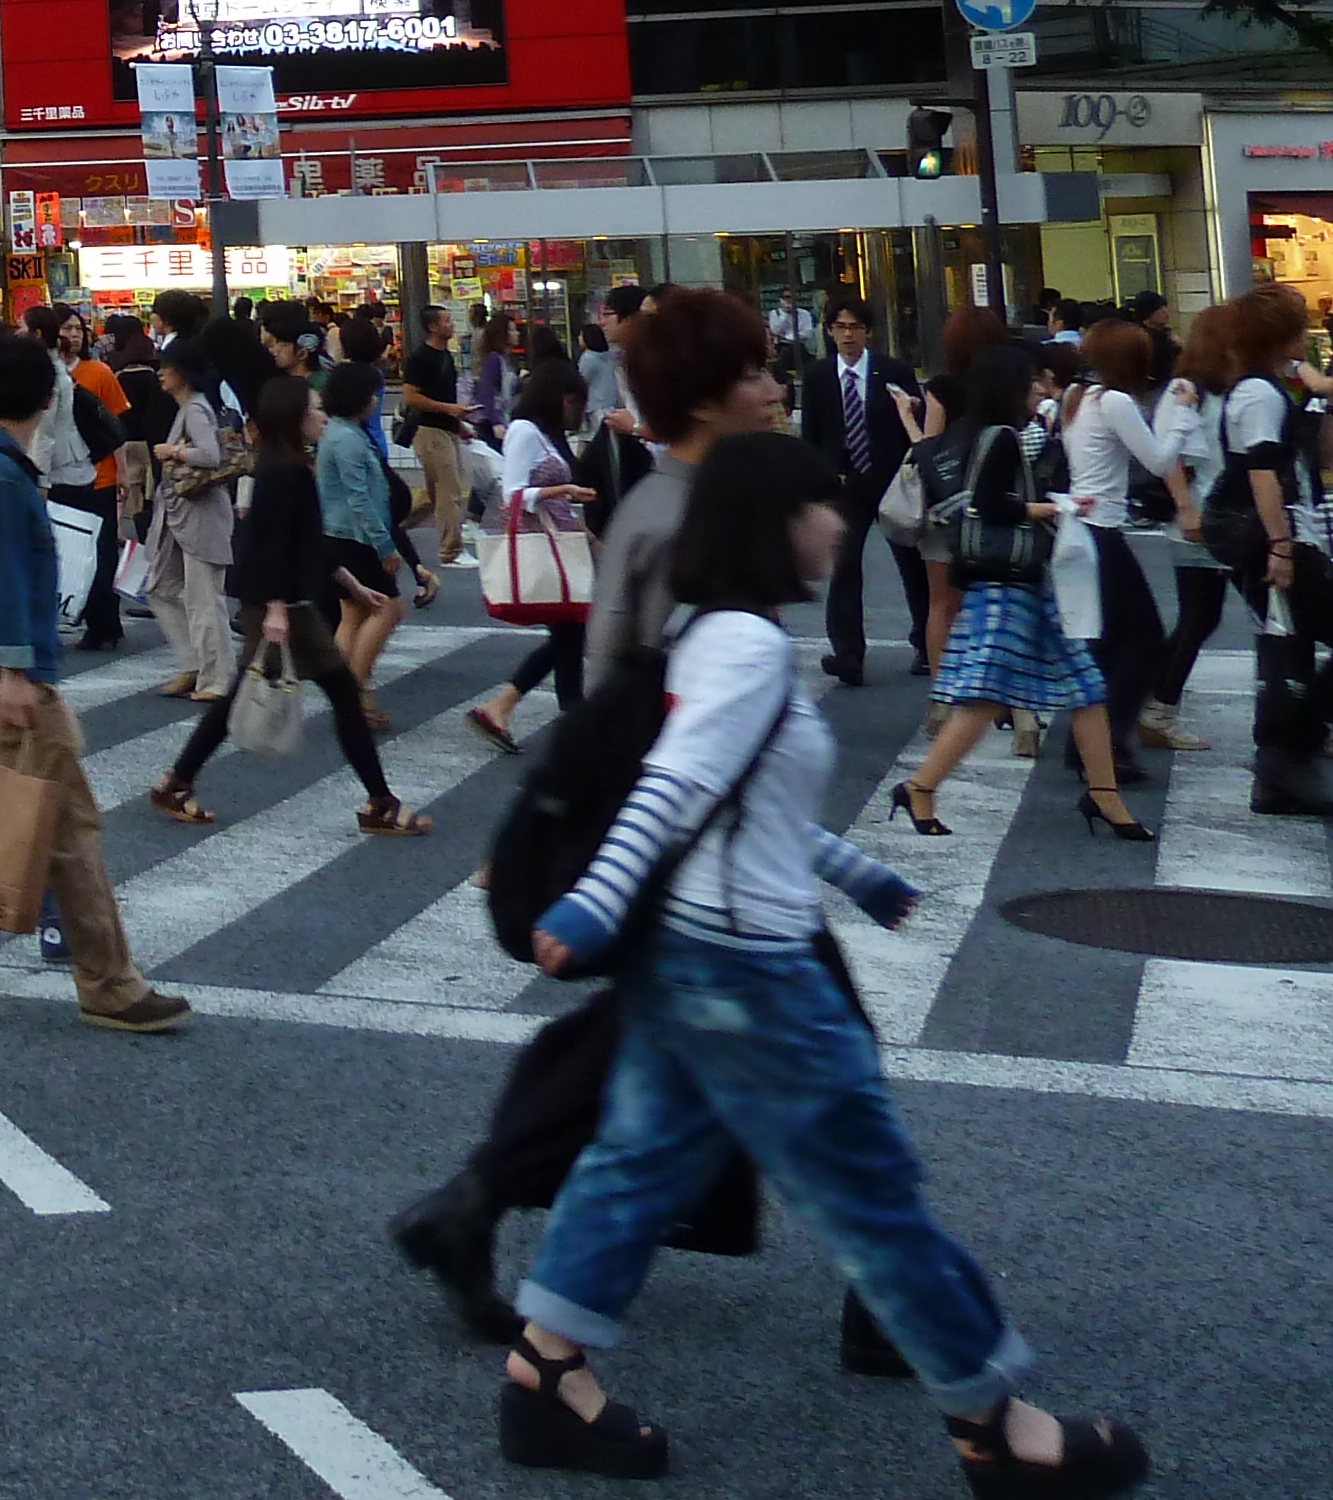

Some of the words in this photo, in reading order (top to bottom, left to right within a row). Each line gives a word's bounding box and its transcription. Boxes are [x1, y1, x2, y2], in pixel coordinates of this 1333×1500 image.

[263, 15, 458, 47] 03-3817-6001
[20, 105, 85, 123] 三千里薬品
[85, 174, 140, 192] クスリ
